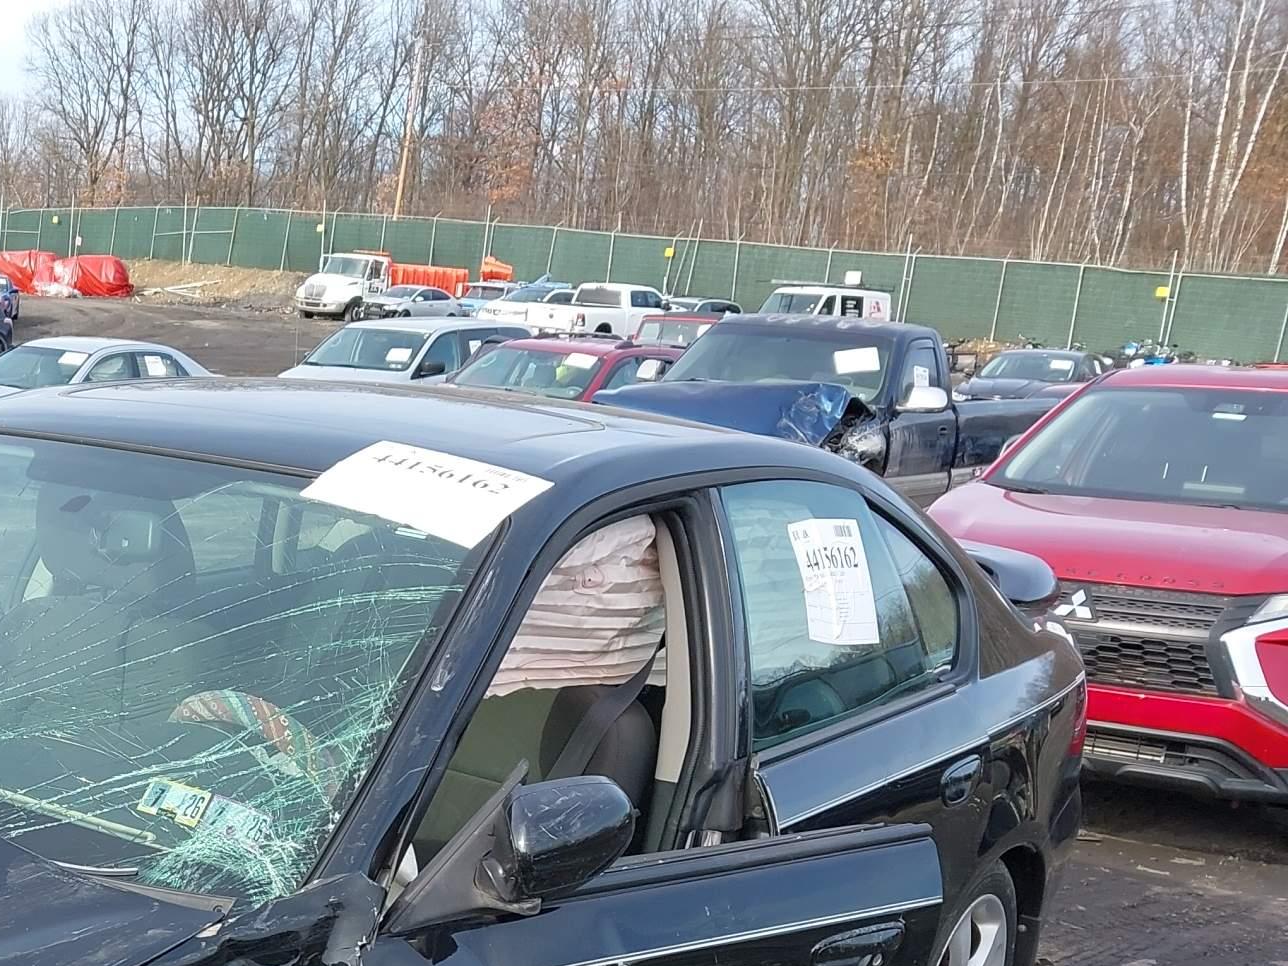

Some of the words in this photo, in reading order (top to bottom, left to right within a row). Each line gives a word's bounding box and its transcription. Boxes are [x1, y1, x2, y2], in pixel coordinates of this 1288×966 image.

[372, 454, 509, 494] 44156162
[806, 546, 859, 572] 44156162
[183, 794, 206, 819] 26
